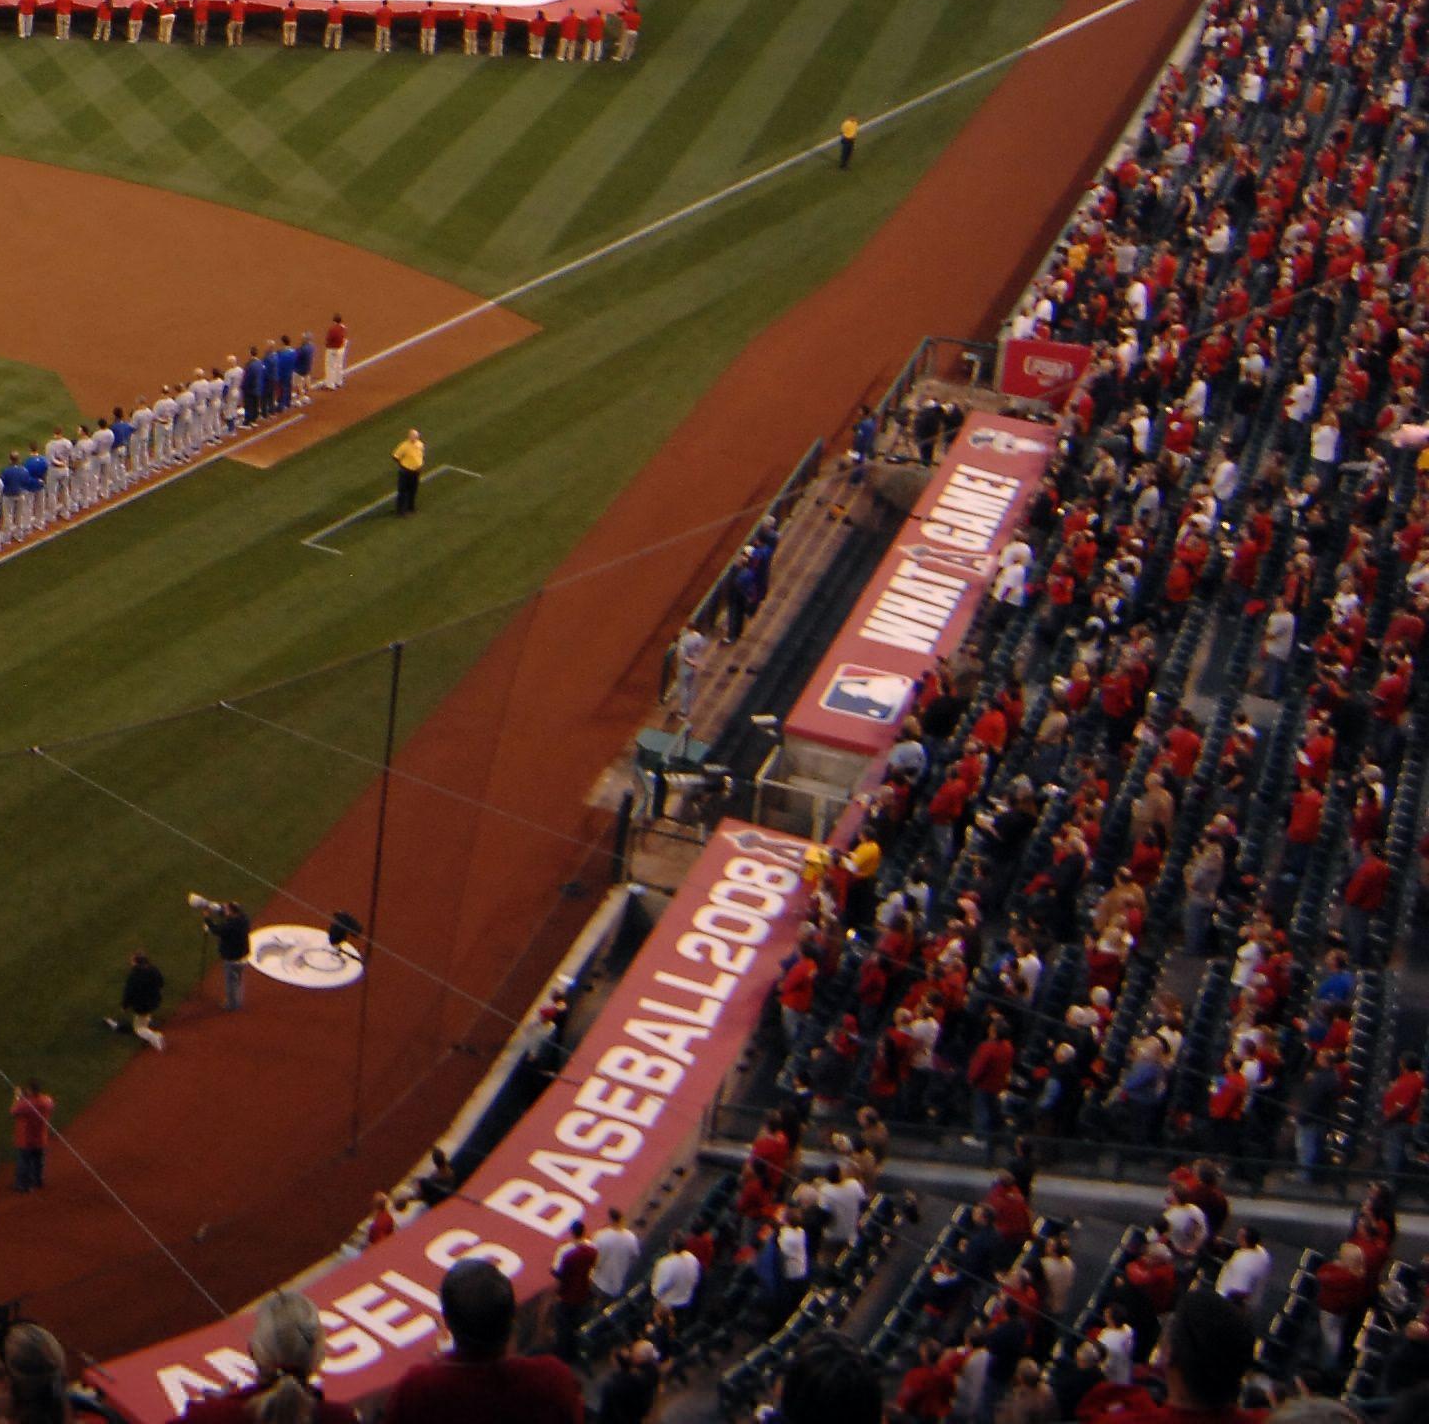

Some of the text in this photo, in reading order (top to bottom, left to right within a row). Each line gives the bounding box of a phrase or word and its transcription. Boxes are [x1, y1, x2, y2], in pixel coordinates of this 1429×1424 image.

[859, 562, 968, 653] WHAT
[922, 464, 1021, 552] GAME!
[482, 855, 801, 1241] BASEBALL 2008
